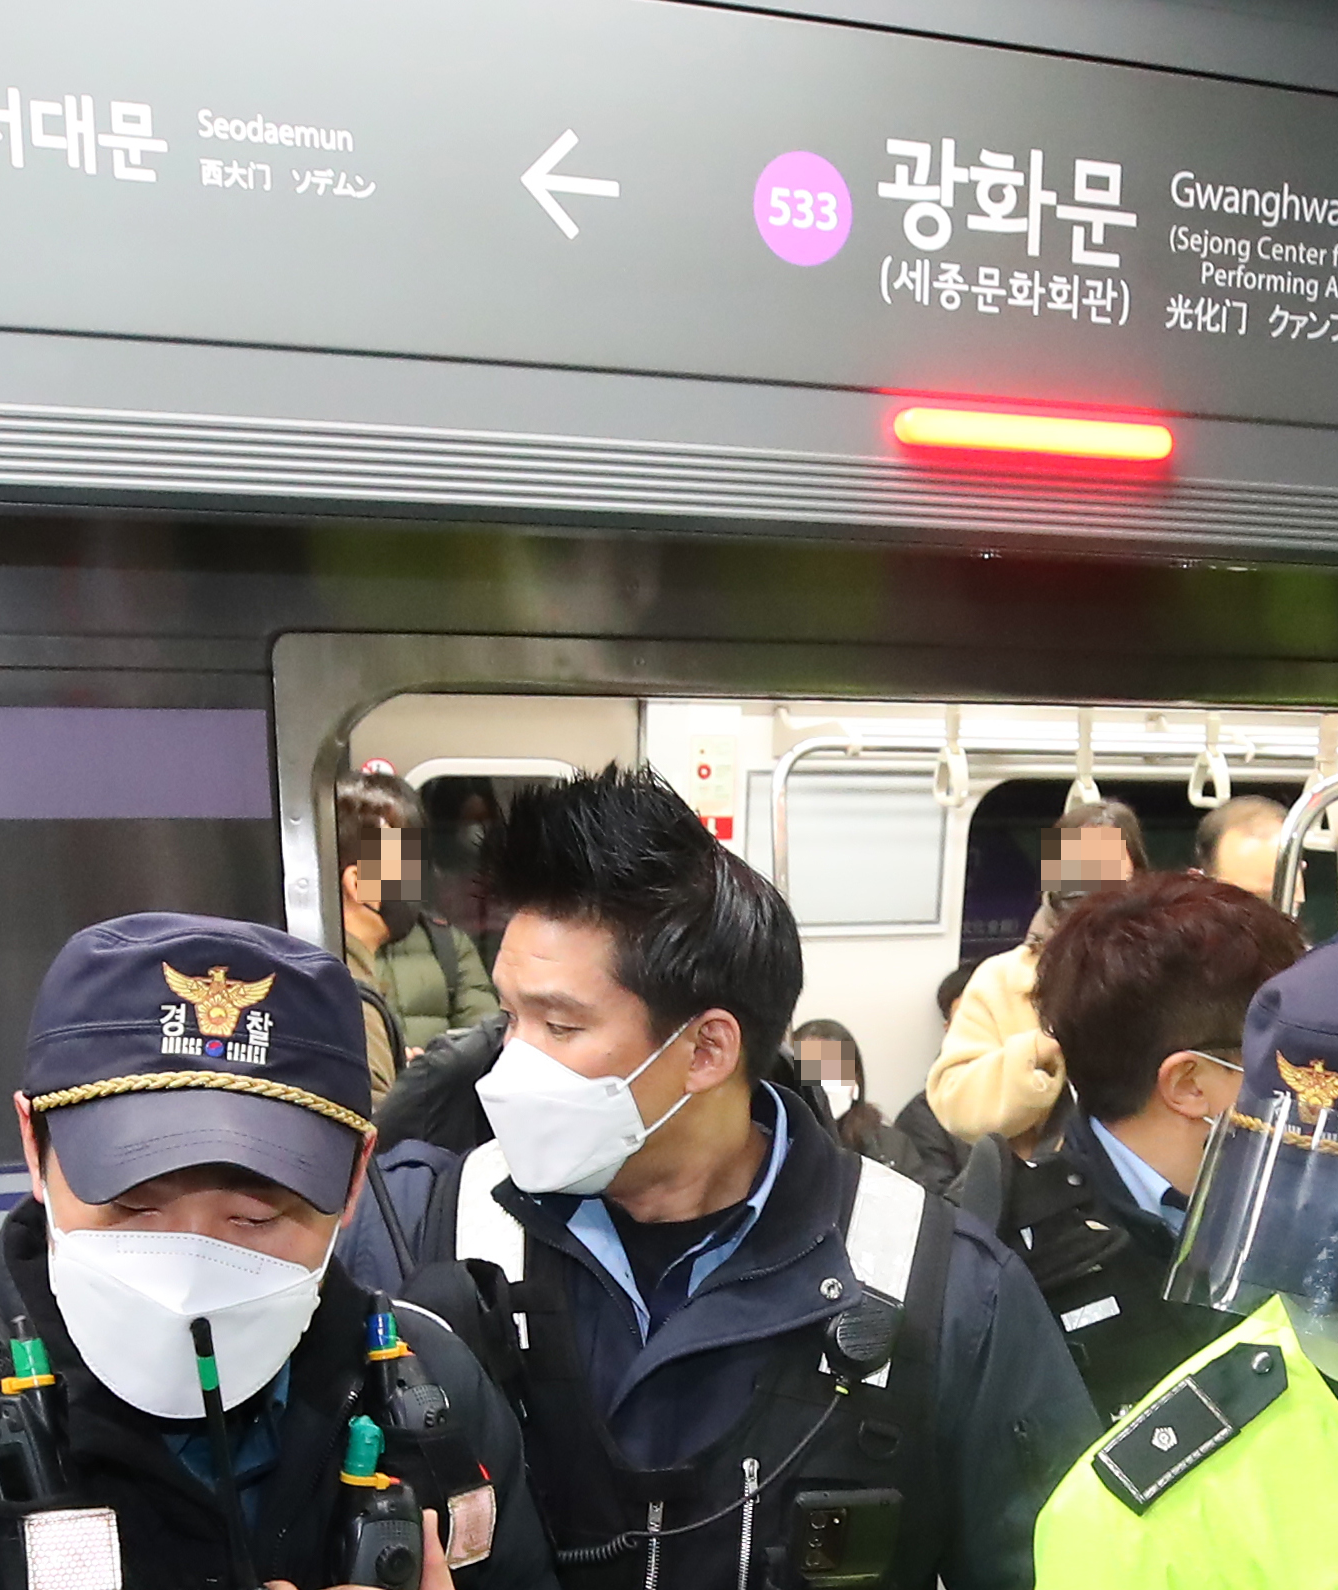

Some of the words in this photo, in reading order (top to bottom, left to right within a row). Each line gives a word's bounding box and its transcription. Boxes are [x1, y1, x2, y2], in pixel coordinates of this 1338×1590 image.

[198, 109, 354, 153] Seodaemun
[769, 187, 838, 232] 533
[877, 137, 1138, 268] 광화문
[1170, 226, 1251, 262] (Sejong
[1258, 234, 1327, 268] Center
[879, 256, 1130, 326] (세종문화회관)
[1200, 261, 1319, 304] Performing
[1166, 294, 1249, 335] 光化门
